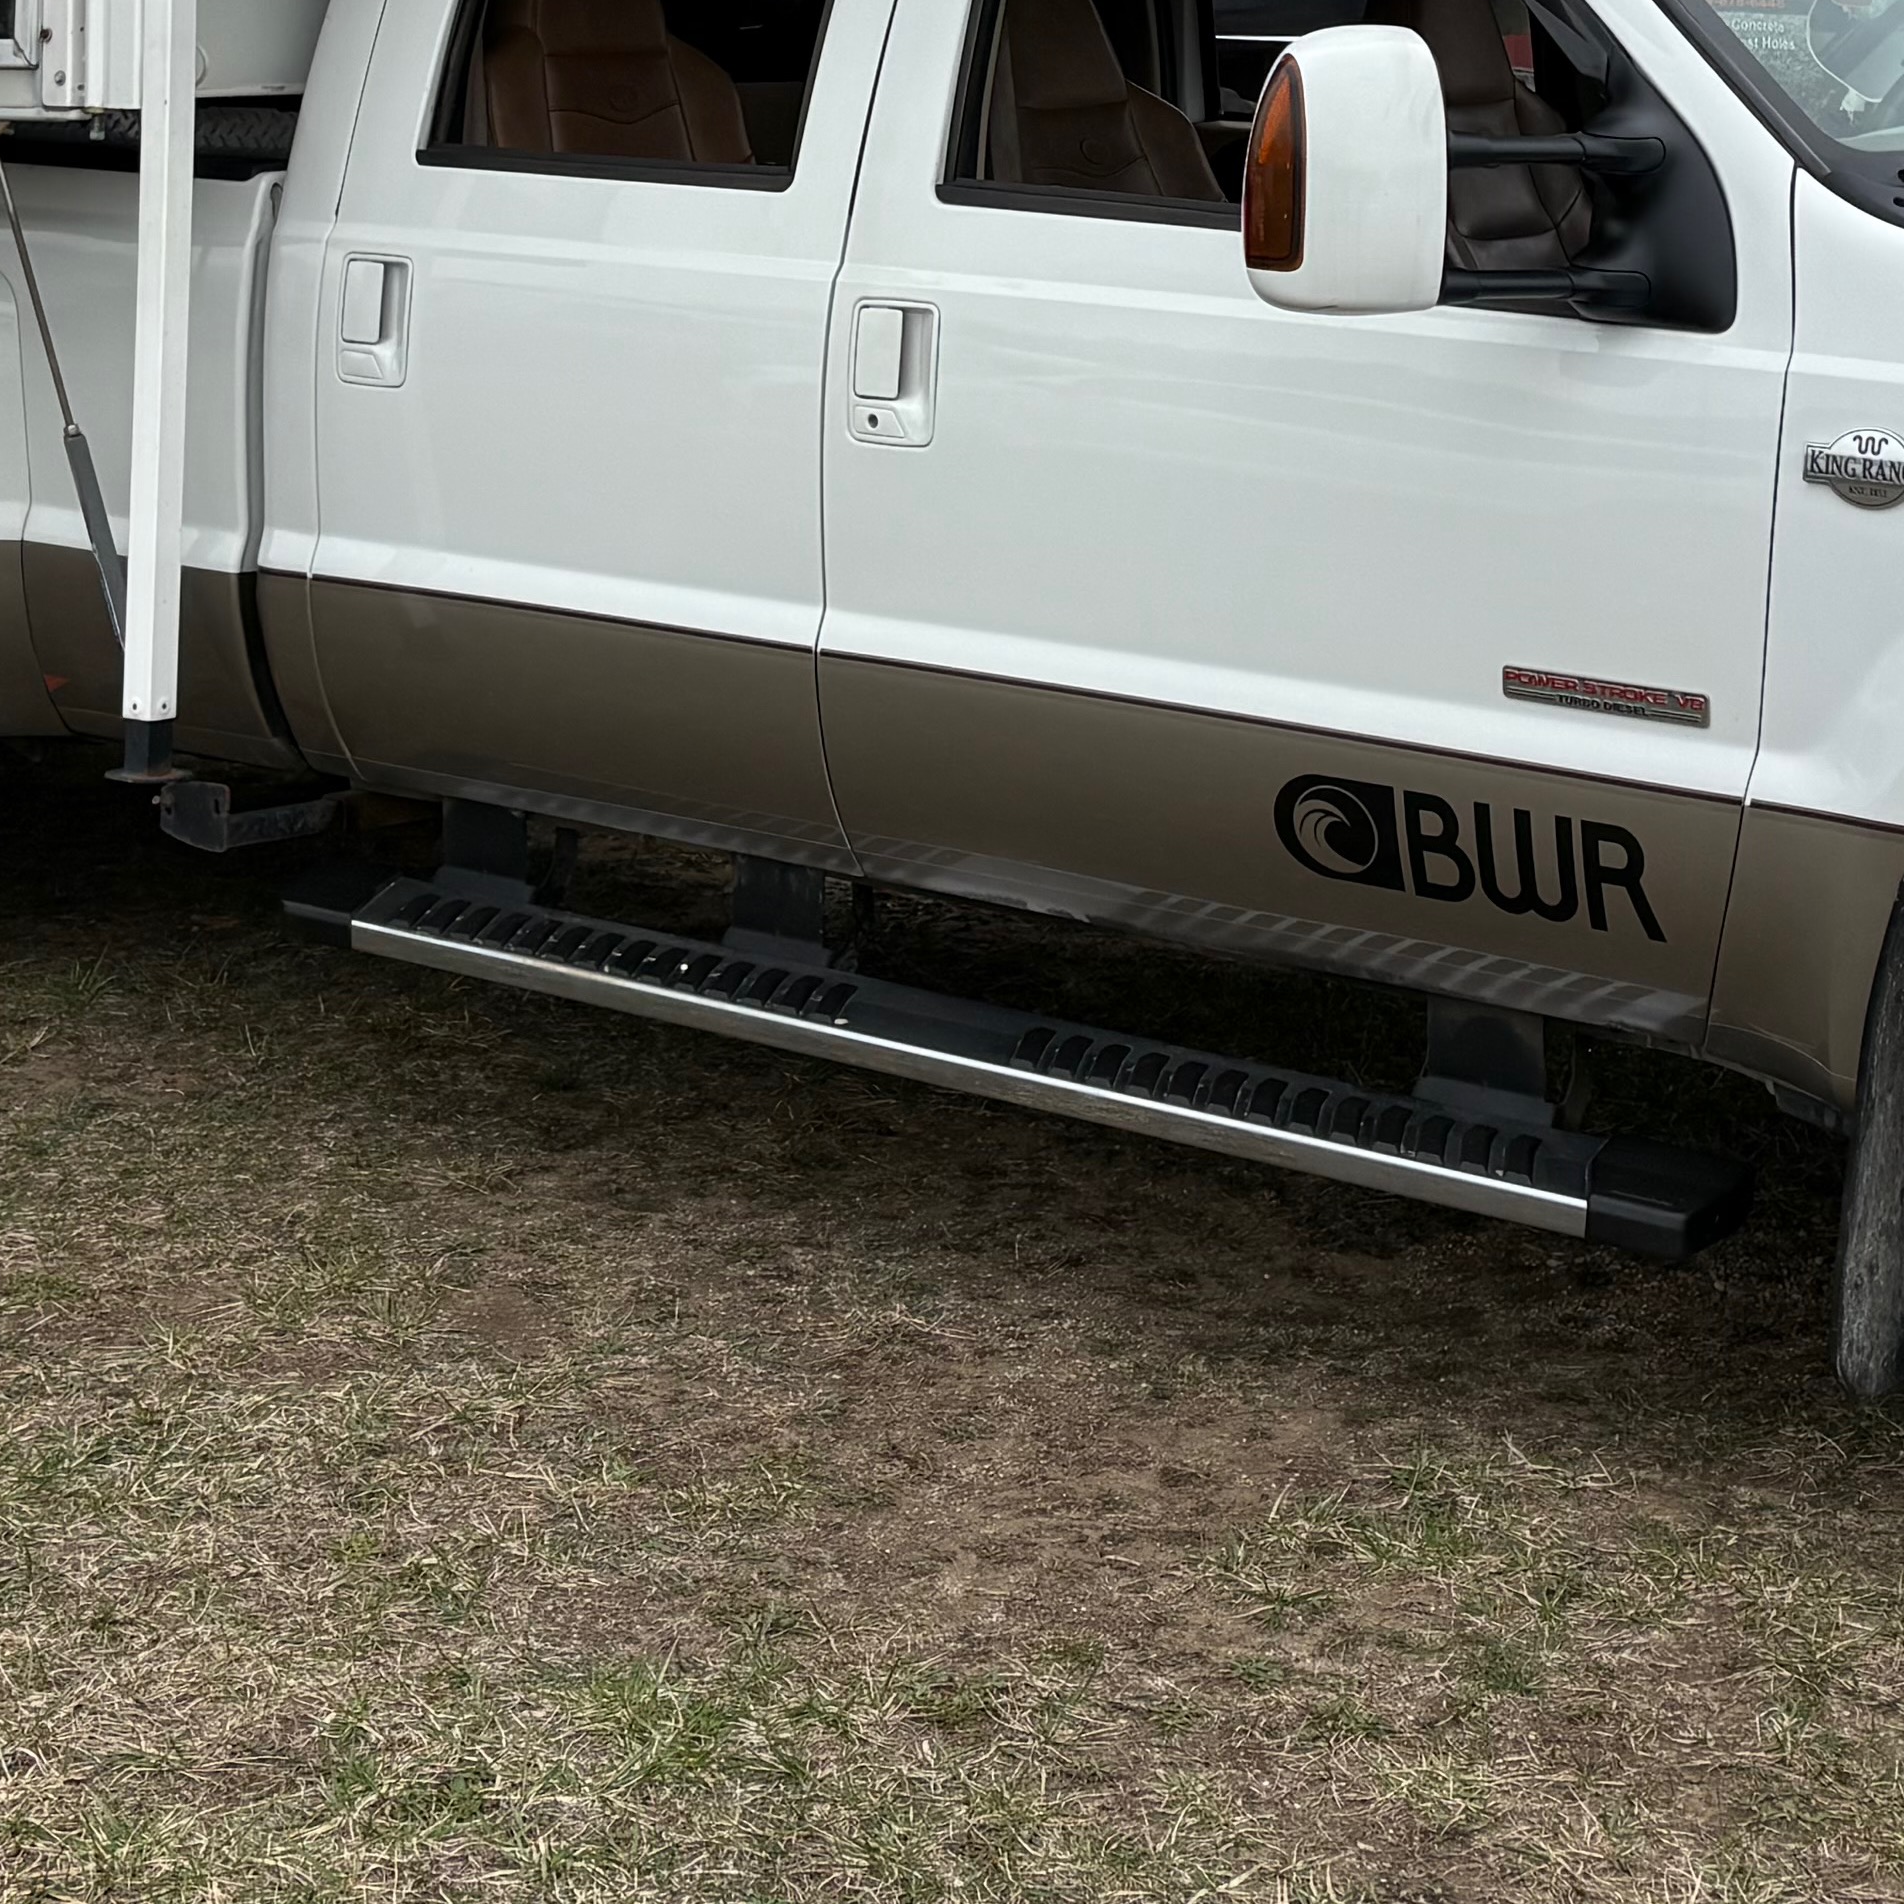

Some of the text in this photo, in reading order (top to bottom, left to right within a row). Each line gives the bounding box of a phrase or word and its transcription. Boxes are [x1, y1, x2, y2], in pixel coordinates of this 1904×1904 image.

[1731, 18, 1784, 33] Concrete
[1762, 36, 1795, 50] Holes
[1810, 449, 1856, 479] KING
[1504, 668, 1580, 691] POWER
[1583, 679, 1669, 705] STROKE
[1555, 694, 1649, 717] TURBO DIESEL
[1403, 790, 1668, 944] BWR
